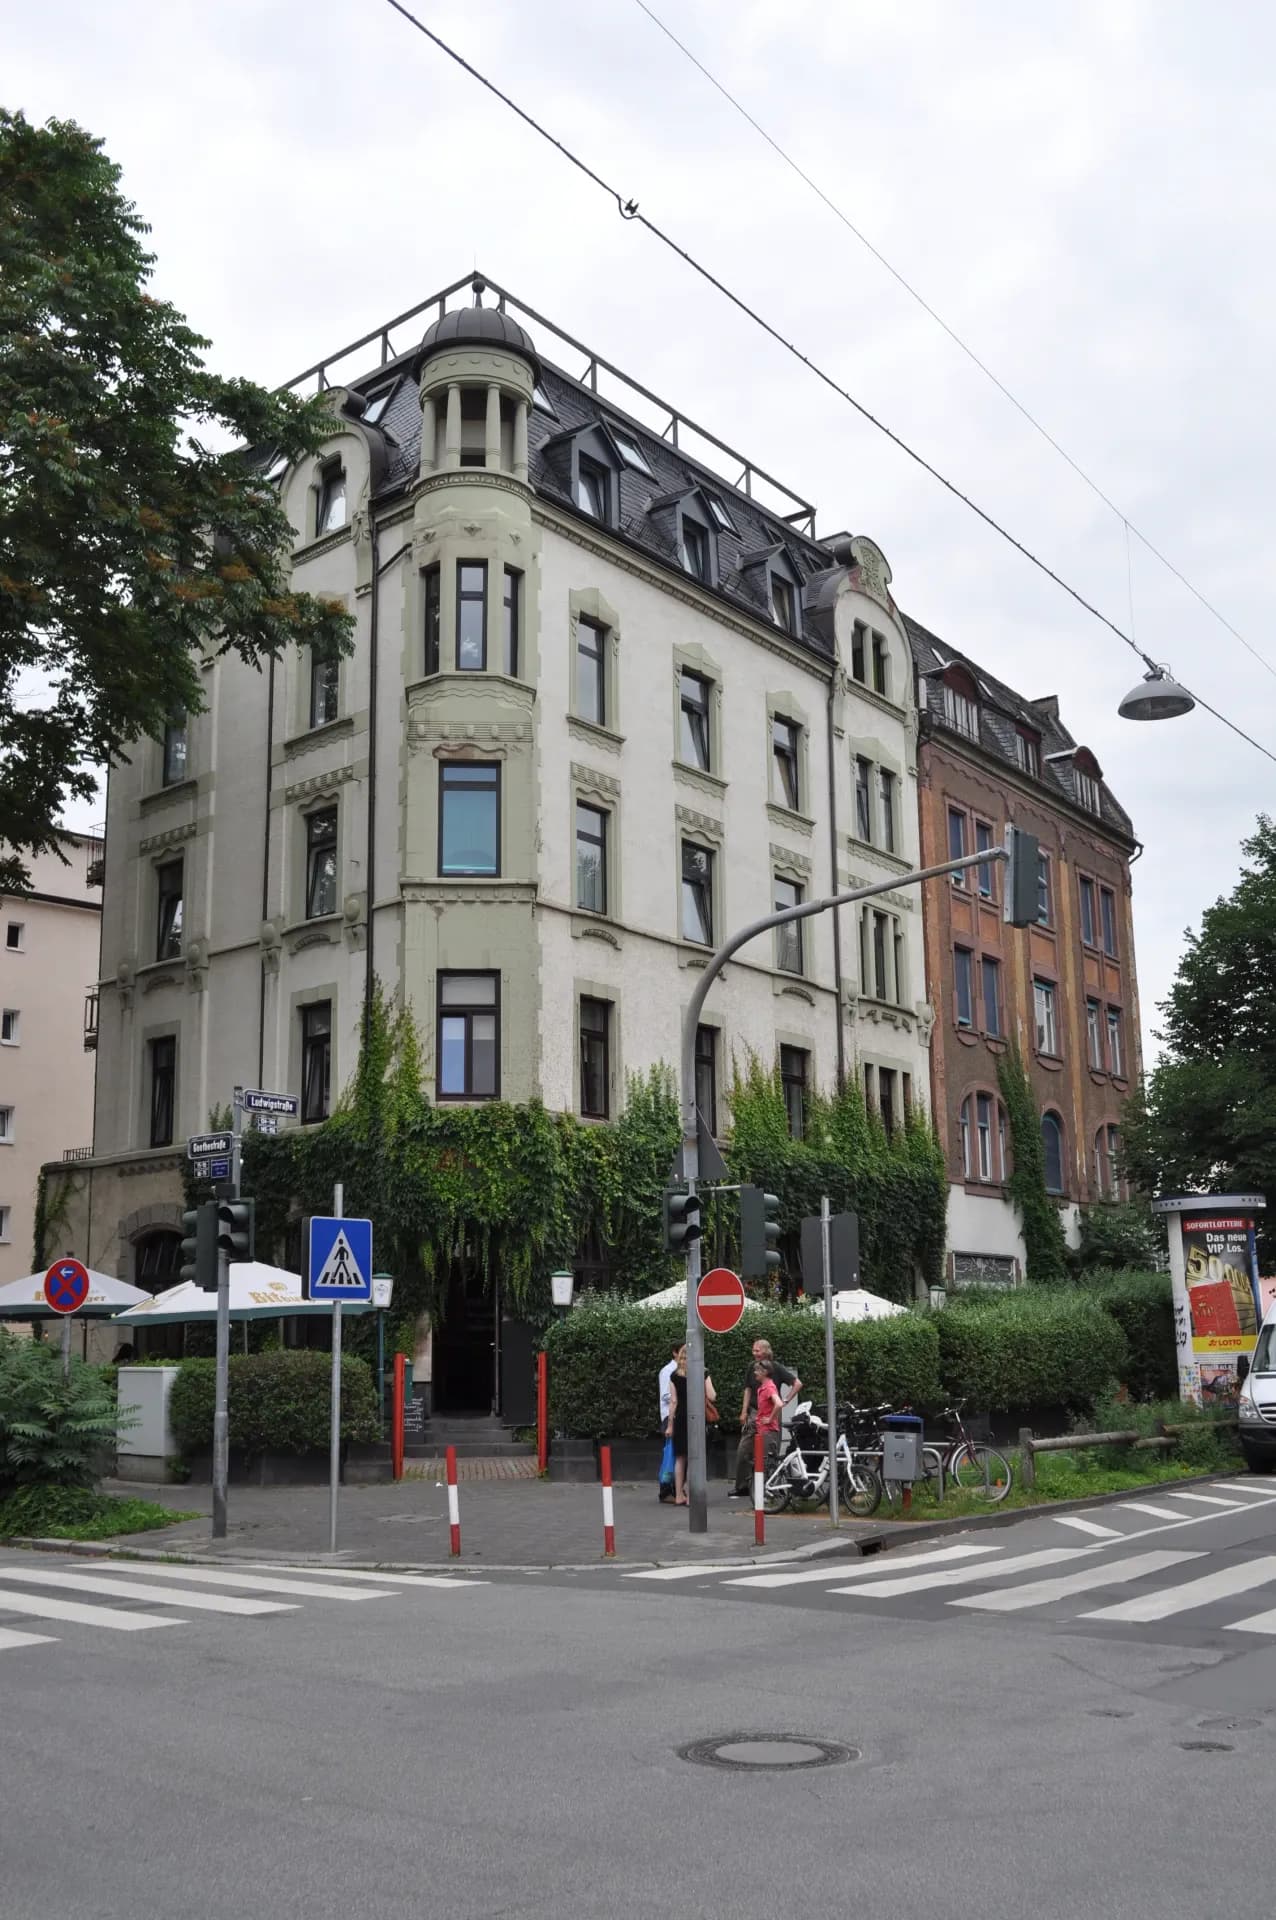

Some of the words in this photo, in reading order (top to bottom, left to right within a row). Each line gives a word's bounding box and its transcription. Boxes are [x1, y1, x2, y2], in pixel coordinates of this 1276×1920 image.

[251, 1096, 293, 1112] Ludwigstraße
[193, 1139, 226, 1153] Goethestraße
[1186, 1220, 1243, 1230] SOFORTLOTTERIE
[1206, 1233, 1225, 1242] Das
[1228, 1233, 1247, 1241] neue
[1207, 1244, 1224, 1253] VIP
[1227, 1243, 1244, 1253] Los.
